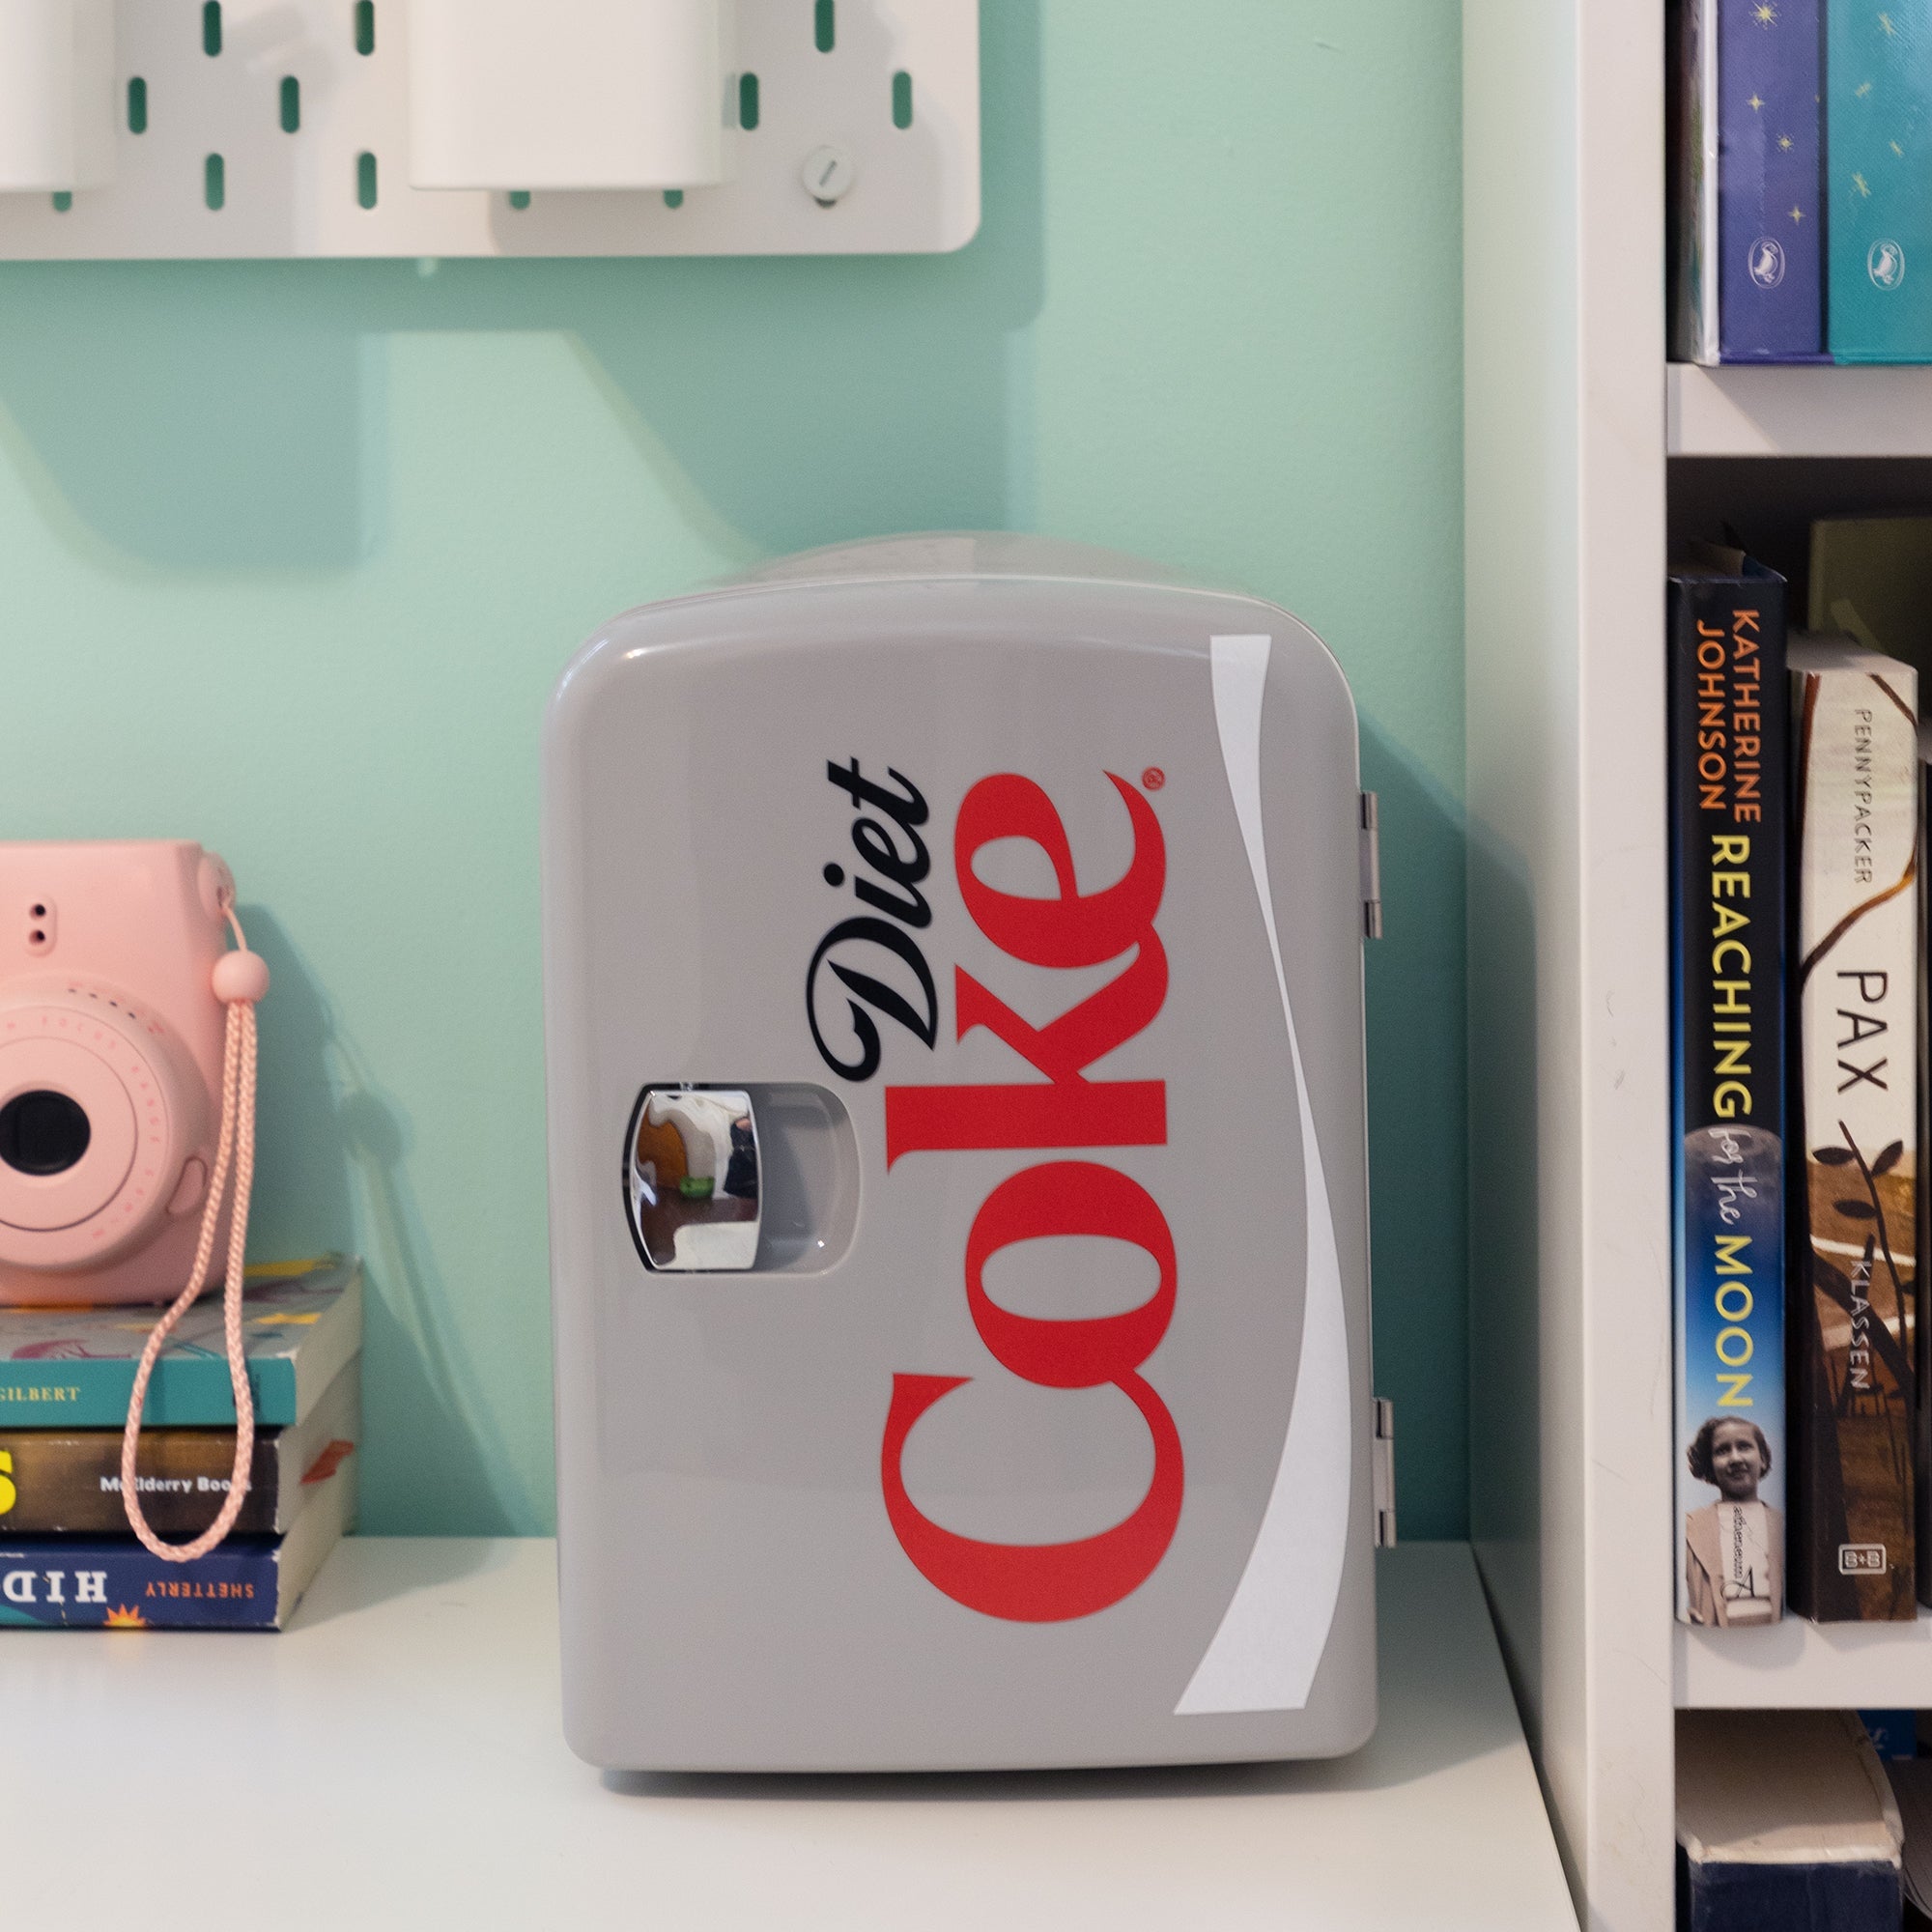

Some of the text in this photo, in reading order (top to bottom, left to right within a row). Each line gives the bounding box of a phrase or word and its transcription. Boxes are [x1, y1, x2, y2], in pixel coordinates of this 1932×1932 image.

[1696, 619, 1727, 810] JOHNSON
[1733, 610, 1762, 823] KATHERINE
[1854, 708, 1873, 884] PENNYPACKER
[806, 756, 939, 1083] Diet
[1707, 835, 1758, 1407] REACHING for the MOON
[1836, 971, 1889, 1094] PAX
[880, 769, 1184, 1624] Coke
[1850, 1260, 1872, 1389] KLASSEN
[99, 1477, 253, 1493] Mlderry Boos
[145, 1580, 255, 1599] SHETTERLY
